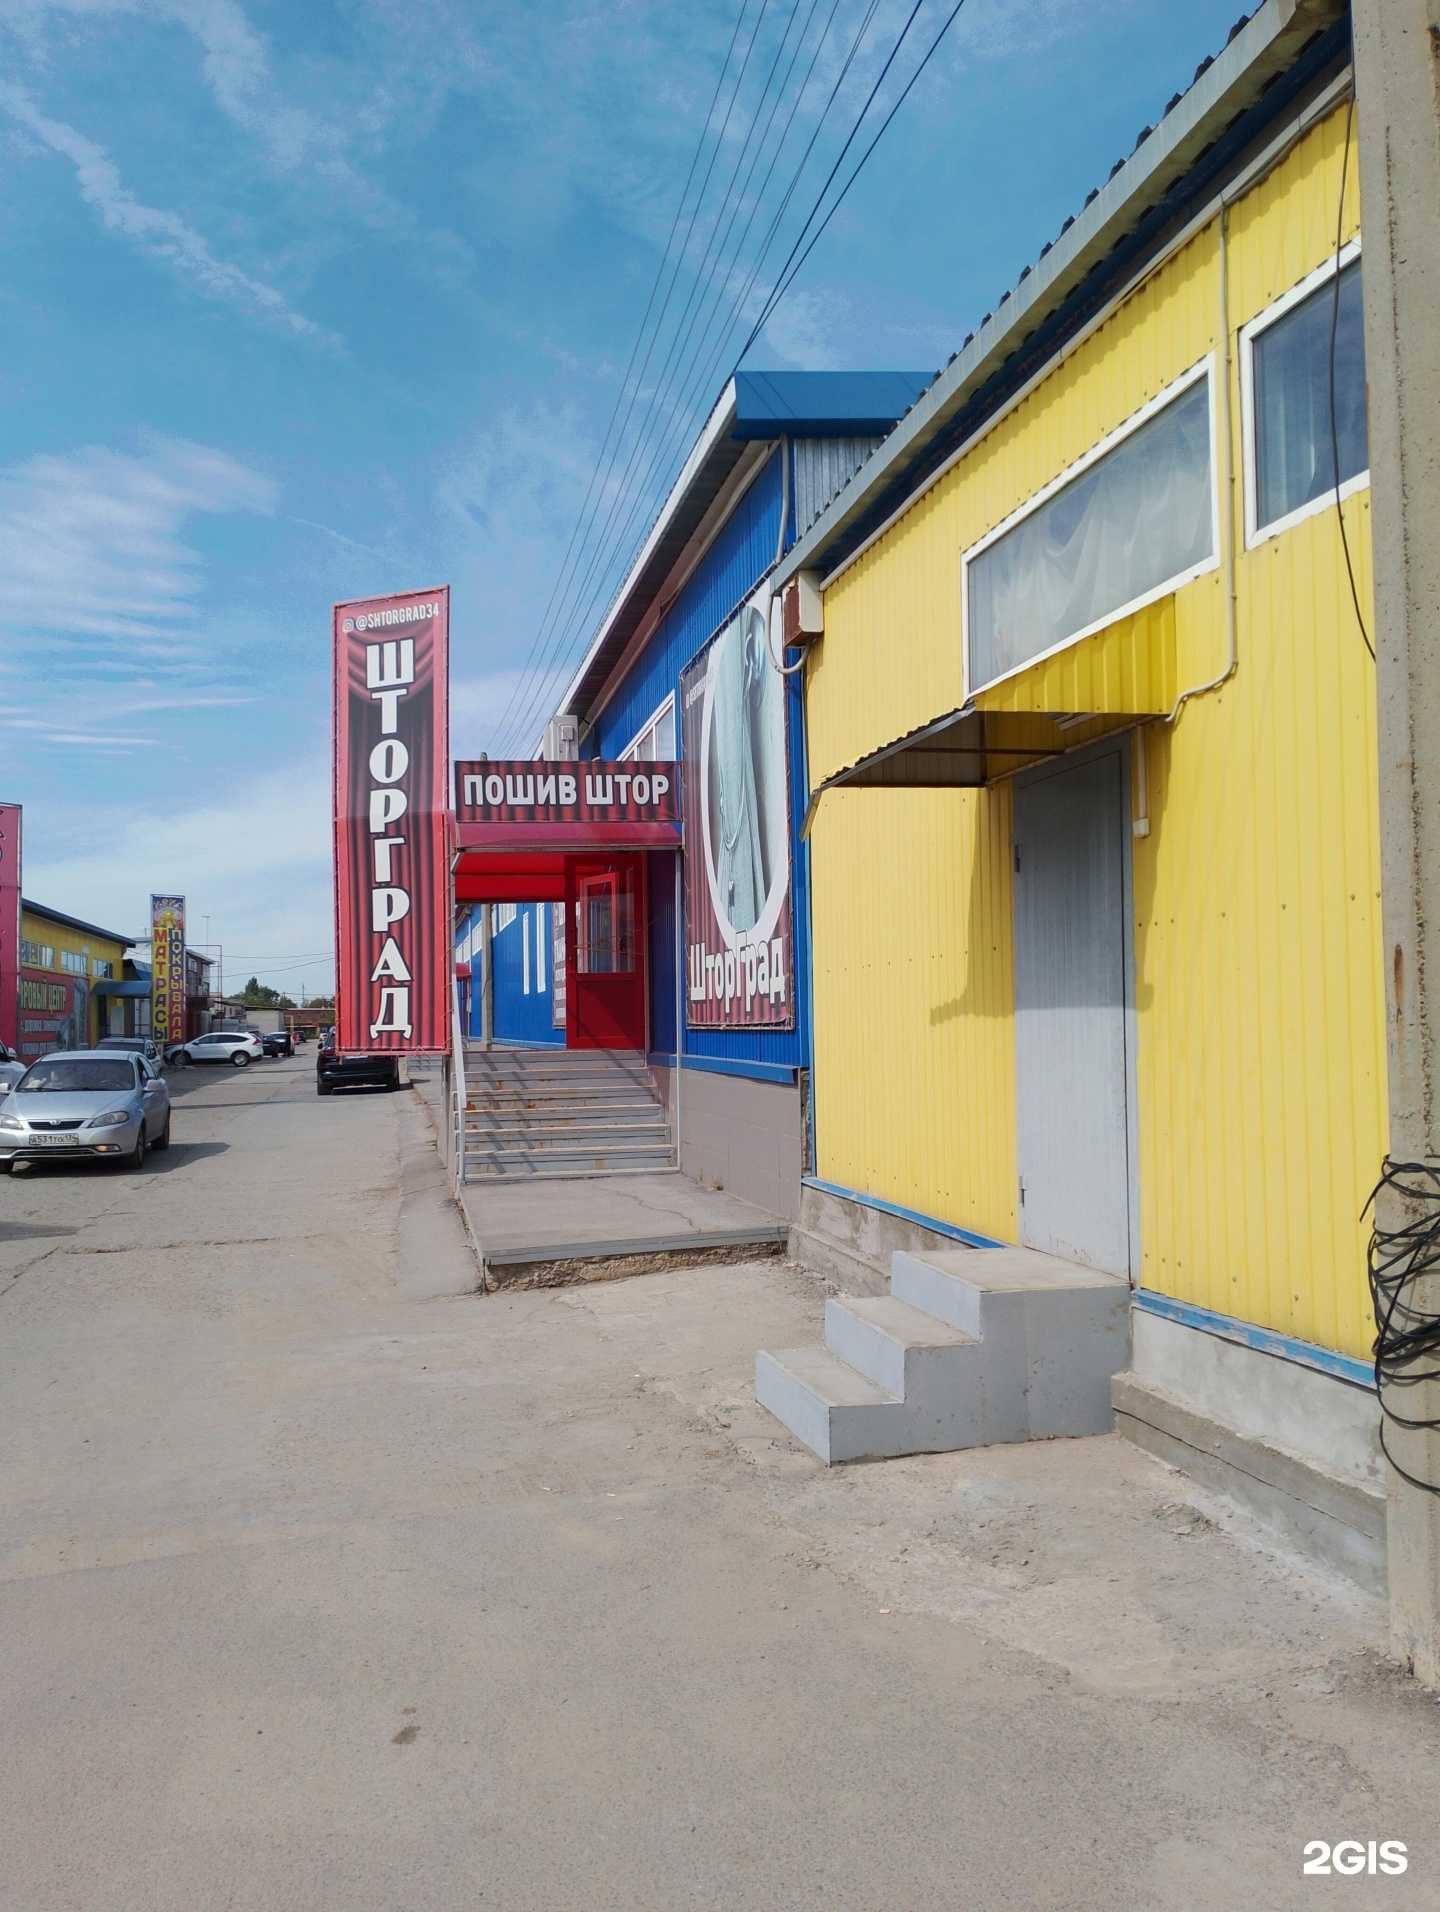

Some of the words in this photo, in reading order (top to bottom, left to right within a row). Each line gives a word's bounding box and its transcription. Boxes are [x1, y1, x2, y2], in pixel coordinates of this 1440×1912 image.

[355, 602, 439, 631] @SHTORGRAD34
[463, 774, 577, 806] ПОШИВ
[585, 774, 669, 806] ШТОР
[366, 638, 415, 1040] ШТОРГРАД
[47, 983, 66, 1014] ЦЕНТР
[153, 928, 168, 1041] МАТРАСЫ
[171, 929, 183, 1040] ПОКРЫВАЛА
